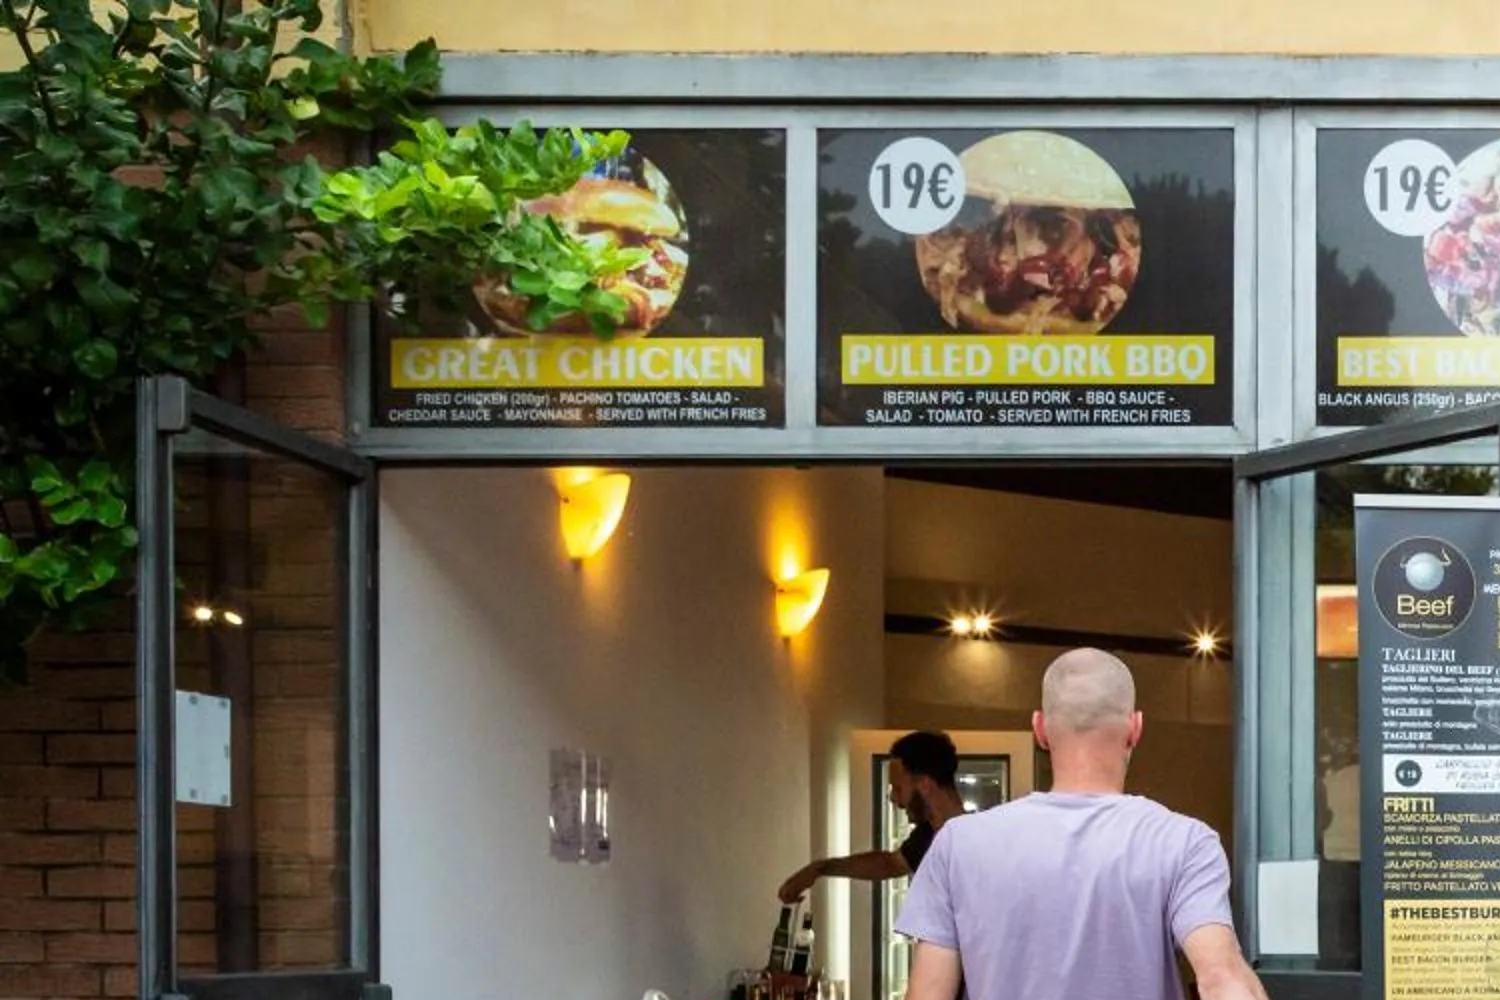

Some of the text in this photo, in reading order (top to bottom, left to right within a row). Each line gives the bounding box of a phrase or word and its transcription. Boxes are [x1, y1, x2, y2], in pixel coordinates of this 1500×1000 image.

[876, 161, 955, 210] 19€
[1373, 164, 1453, 214] 19€
[401, 346, 754, 382] GREAT CHICKEN
[848, 344, 1206, 381] PULLED PORK BBQ
[1343, 350, 1419, 379] BEST
[416, 393, 451, 405] FRIED
[454, 393, 508, 405] CHICKEN
[560, 393, 612, 405] PACHINO
[616, 392, 681, 405] TOMATOES
[691, 392, 731, 404] SALAD
[883, 391, 1165, 406] IBERIAN PIG PULLED PORK BBQ SAUCE
[1318, 393, 1363, 406] BLACK
[1365, 393, 1410, 406] ANGUS
[389, 408, 767, 421] CHEDDAR SAUCE MAYONNAISE SERVED WITH FRENCH FRIES
[866, 410, 1191, 423] SALAD TOMATO SERVED WITH FRENCH FRIES
[1397, 595, 1455, 615] Beef
[1382, 648, 1455, 661] TAGLIERI
[1383, 797, 1434, 812] FRITTI
